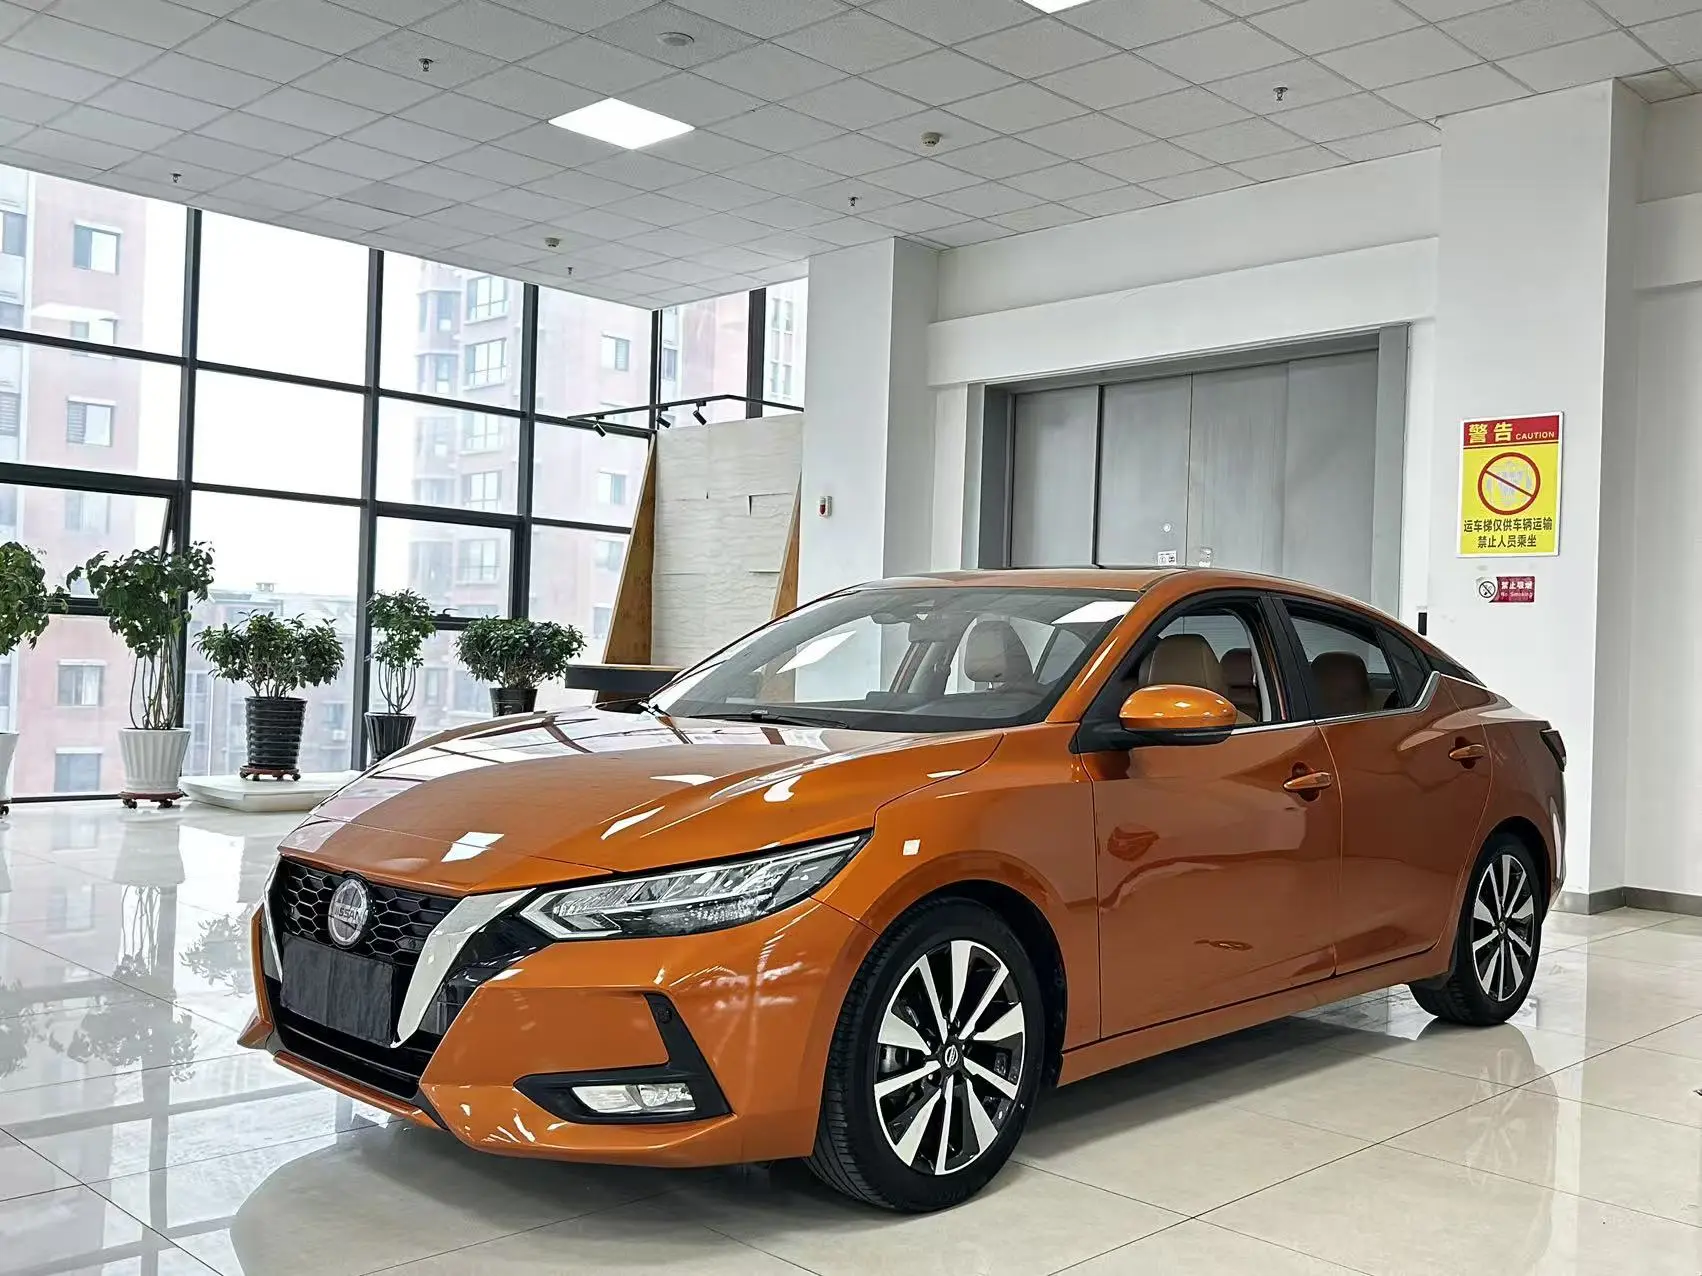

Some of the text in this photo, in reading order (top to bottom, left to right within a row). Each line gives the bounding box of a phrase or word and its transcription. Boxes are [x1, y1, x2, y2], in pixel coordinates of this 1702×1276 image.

[1468, 421, 1555, 444] 警告 CAUTION
[1463, 517, 1553, 533] 运车梯仅供车辆运输
[1477, 534, 1537, 549] 禁止人员乘坐
